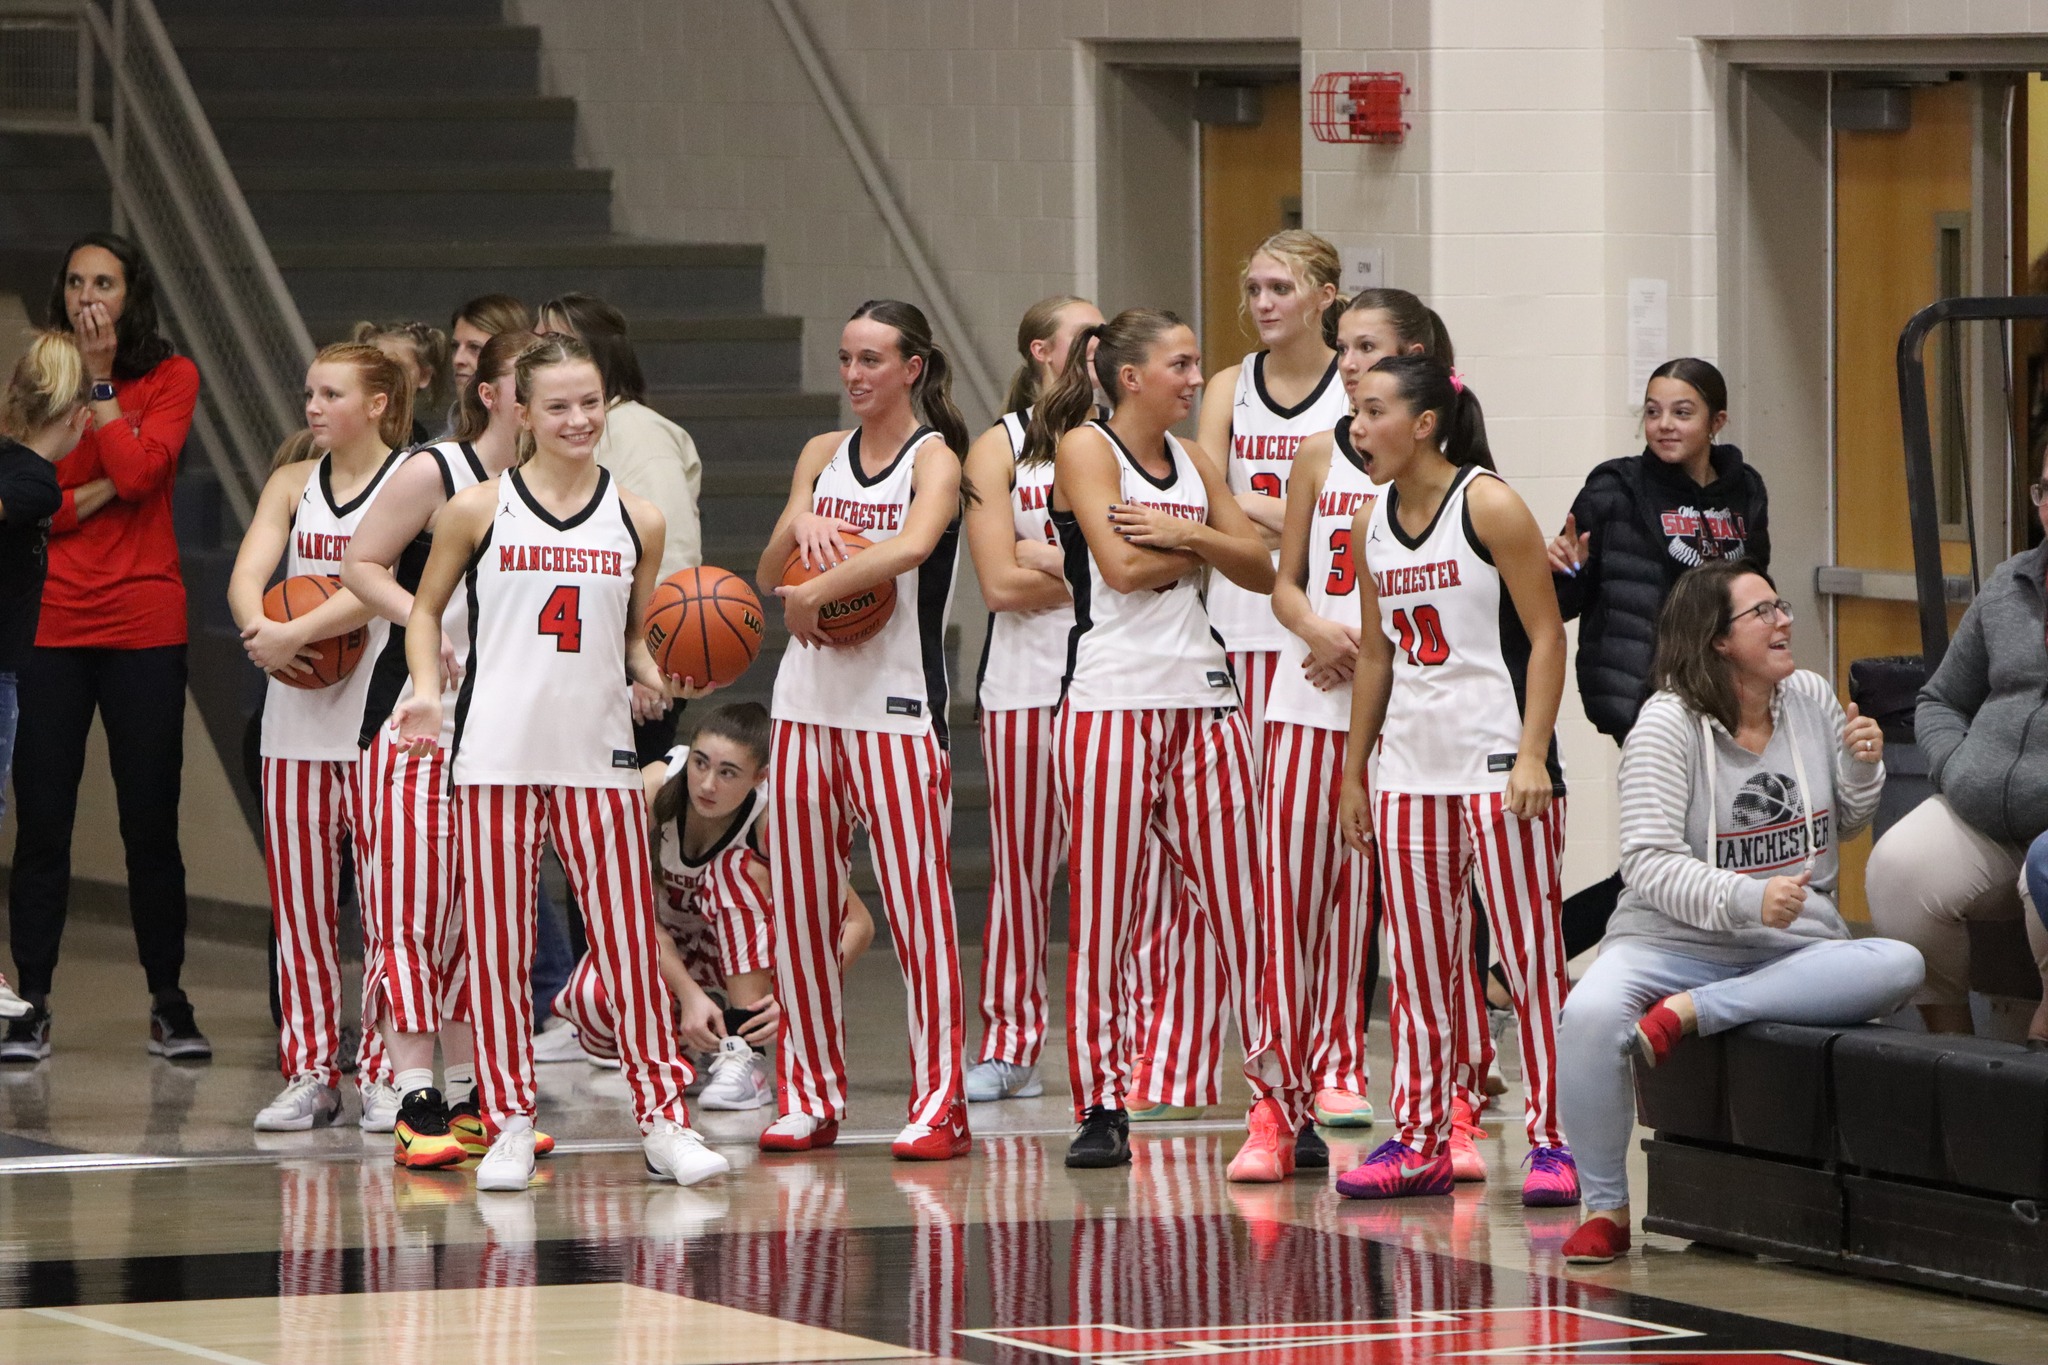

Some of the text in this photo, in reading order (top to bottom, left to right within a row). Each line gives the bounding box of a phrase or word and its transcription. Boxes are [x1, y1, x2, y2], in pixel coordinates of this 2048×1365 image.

[1234, 434, 1307, 460] MANCHE
[499, 545, 622, 577] MANCHESTER
[538, 585, 582, 653] 4
[1392, 604, 1450, 666] 10
